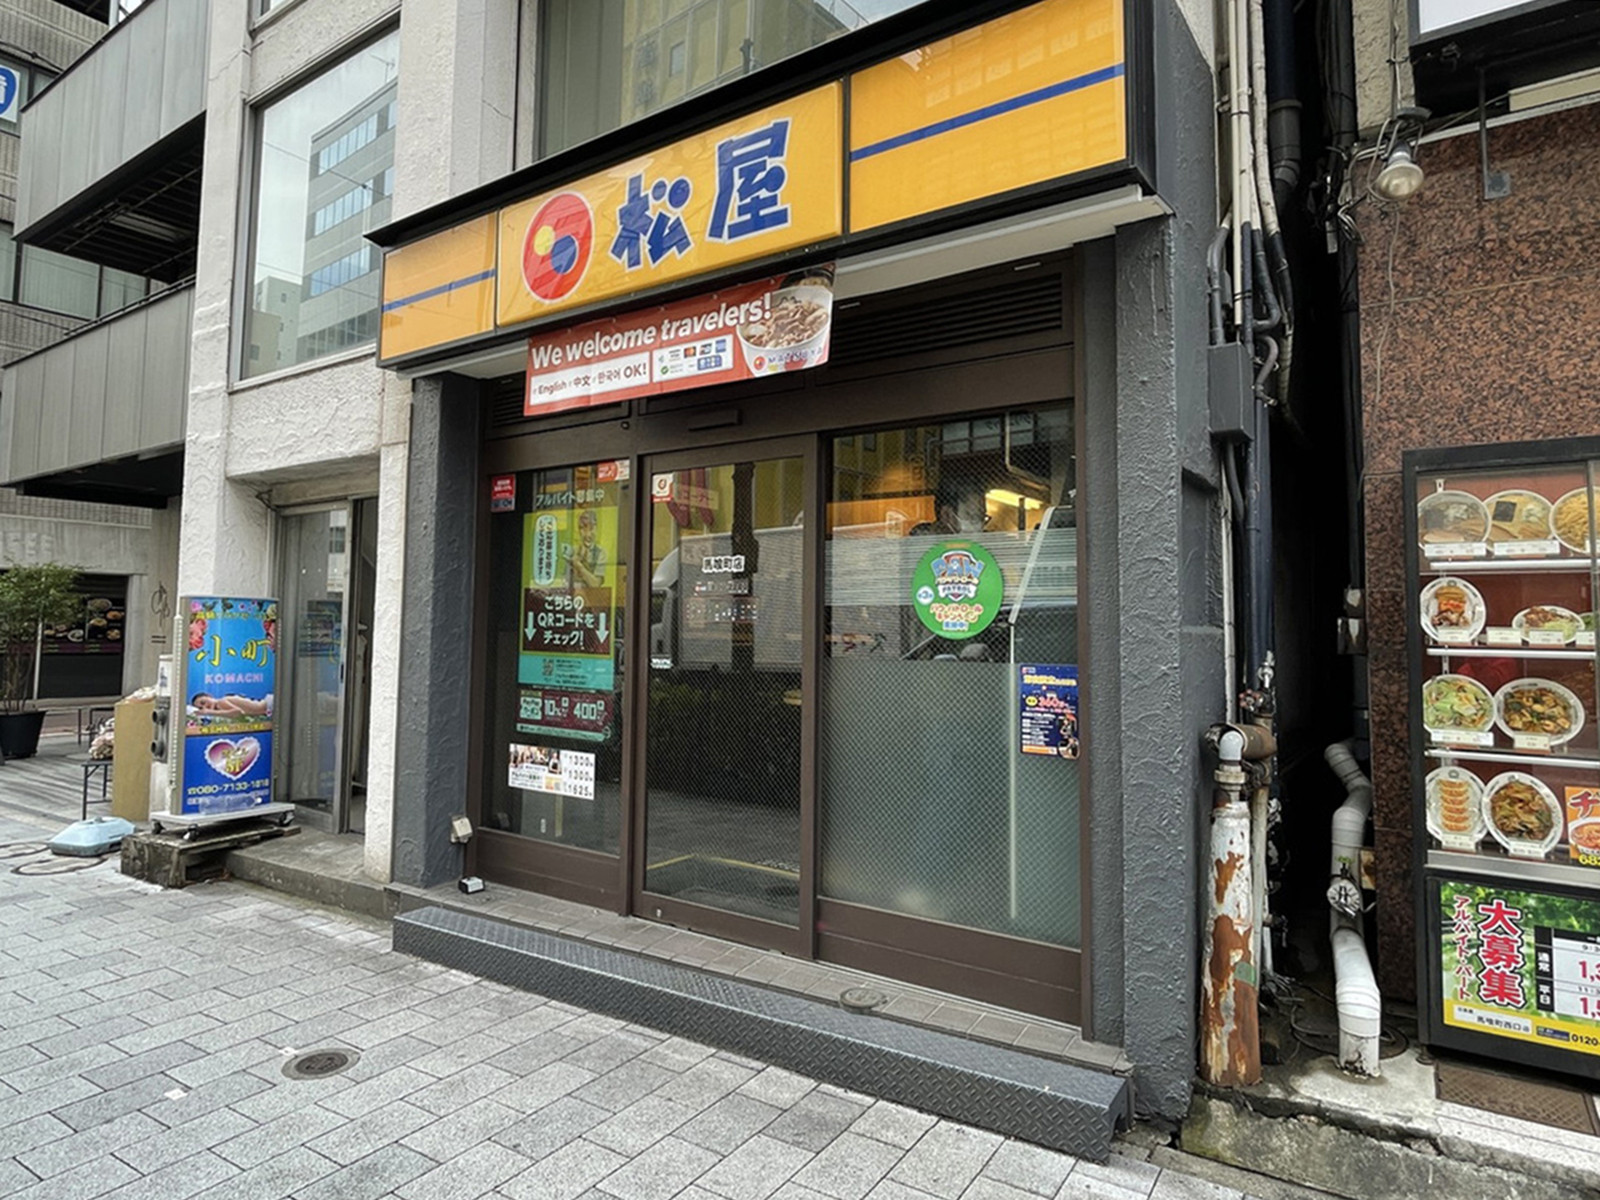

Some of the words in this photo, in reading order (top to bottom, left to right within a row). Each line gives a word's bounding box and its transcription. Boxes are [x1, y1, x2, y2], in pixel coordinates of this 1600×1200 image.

[609, 118, 791, 269] 松屋
[532, 344, 563, 369] We
[565, 325, 656, 358] welcome
[661, 292, 773, 342] travelers!
[538, 381, 567, 395] English
[573, 375, 591, 387] 中文
[623, 363, 647, 378] OK!
[537, 611, 595, 628] QRコードを
[544, 595, 584, 611] こちらの
[195, 633, 272, 667] 小町
[204, 673, 264, 685] KOMACHI
[1453, 895, 1473, 1000] アルバイト・パート
[1479, 899, 1525, 1007] 大募集
